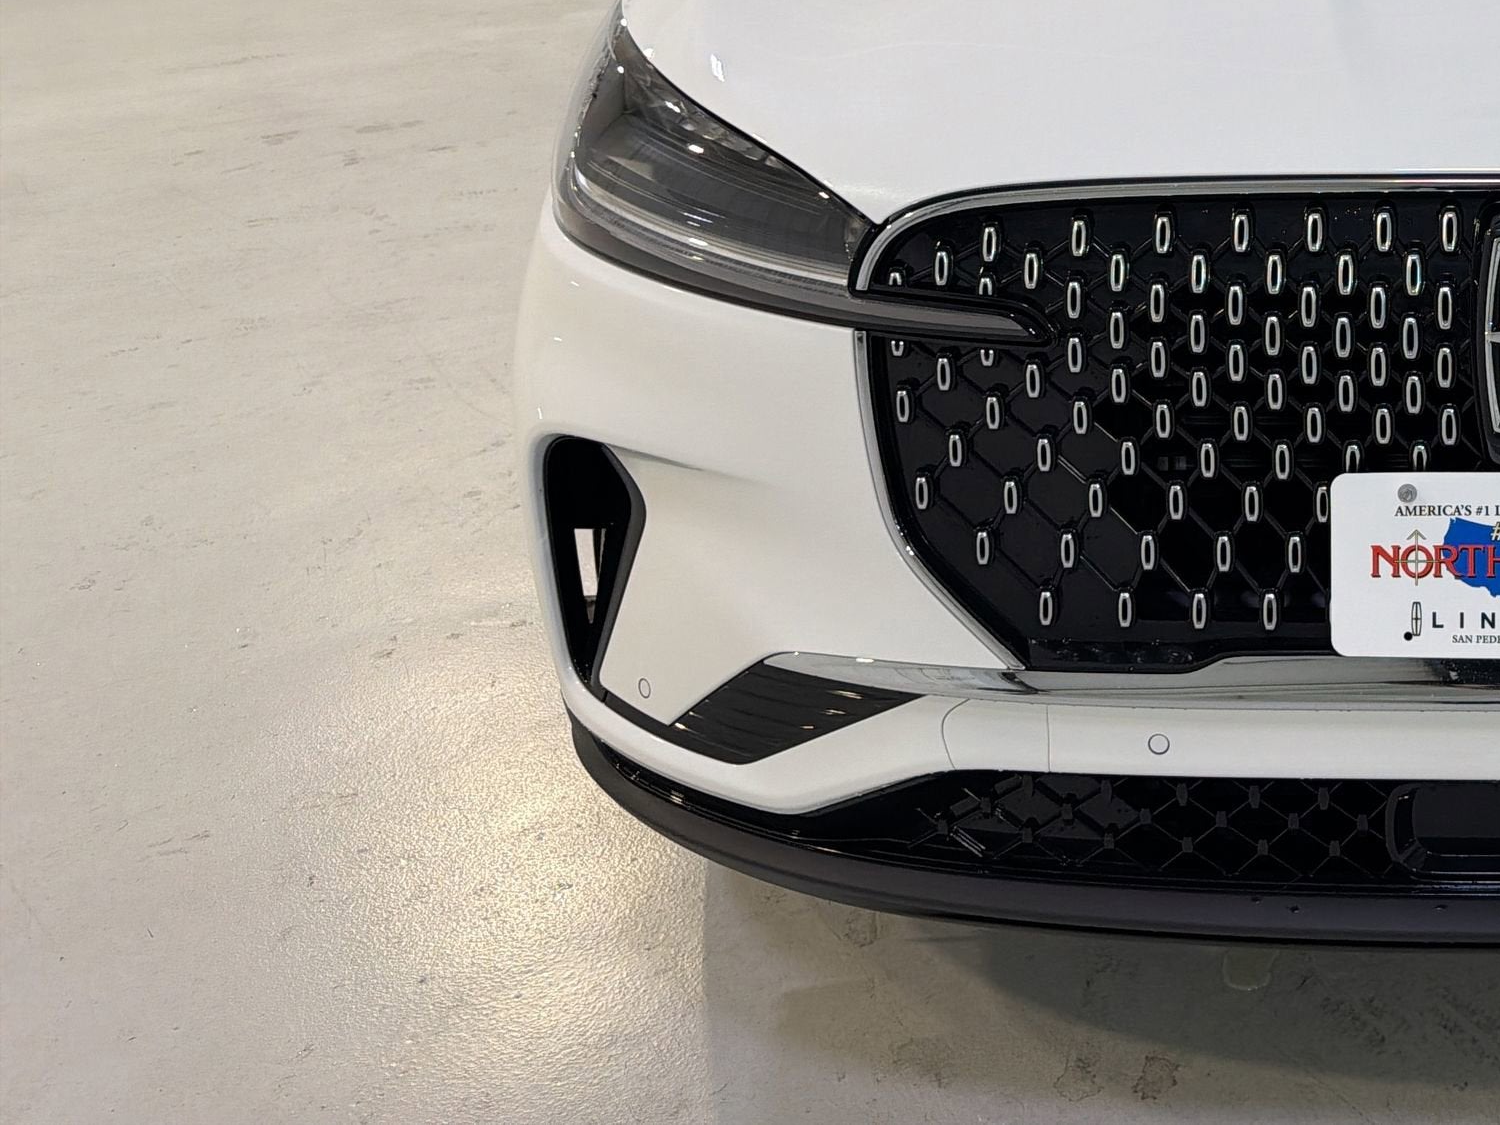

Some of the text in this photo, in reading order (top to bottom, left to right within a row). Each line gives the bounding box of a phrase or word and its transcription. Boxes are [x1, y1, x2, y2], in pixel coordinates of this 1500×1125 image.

[1394, 504, 1472, 517] AMERICA'S
[1475, 505, 1490, 516] #1
[1452, 634, 1473, 644] SAN
